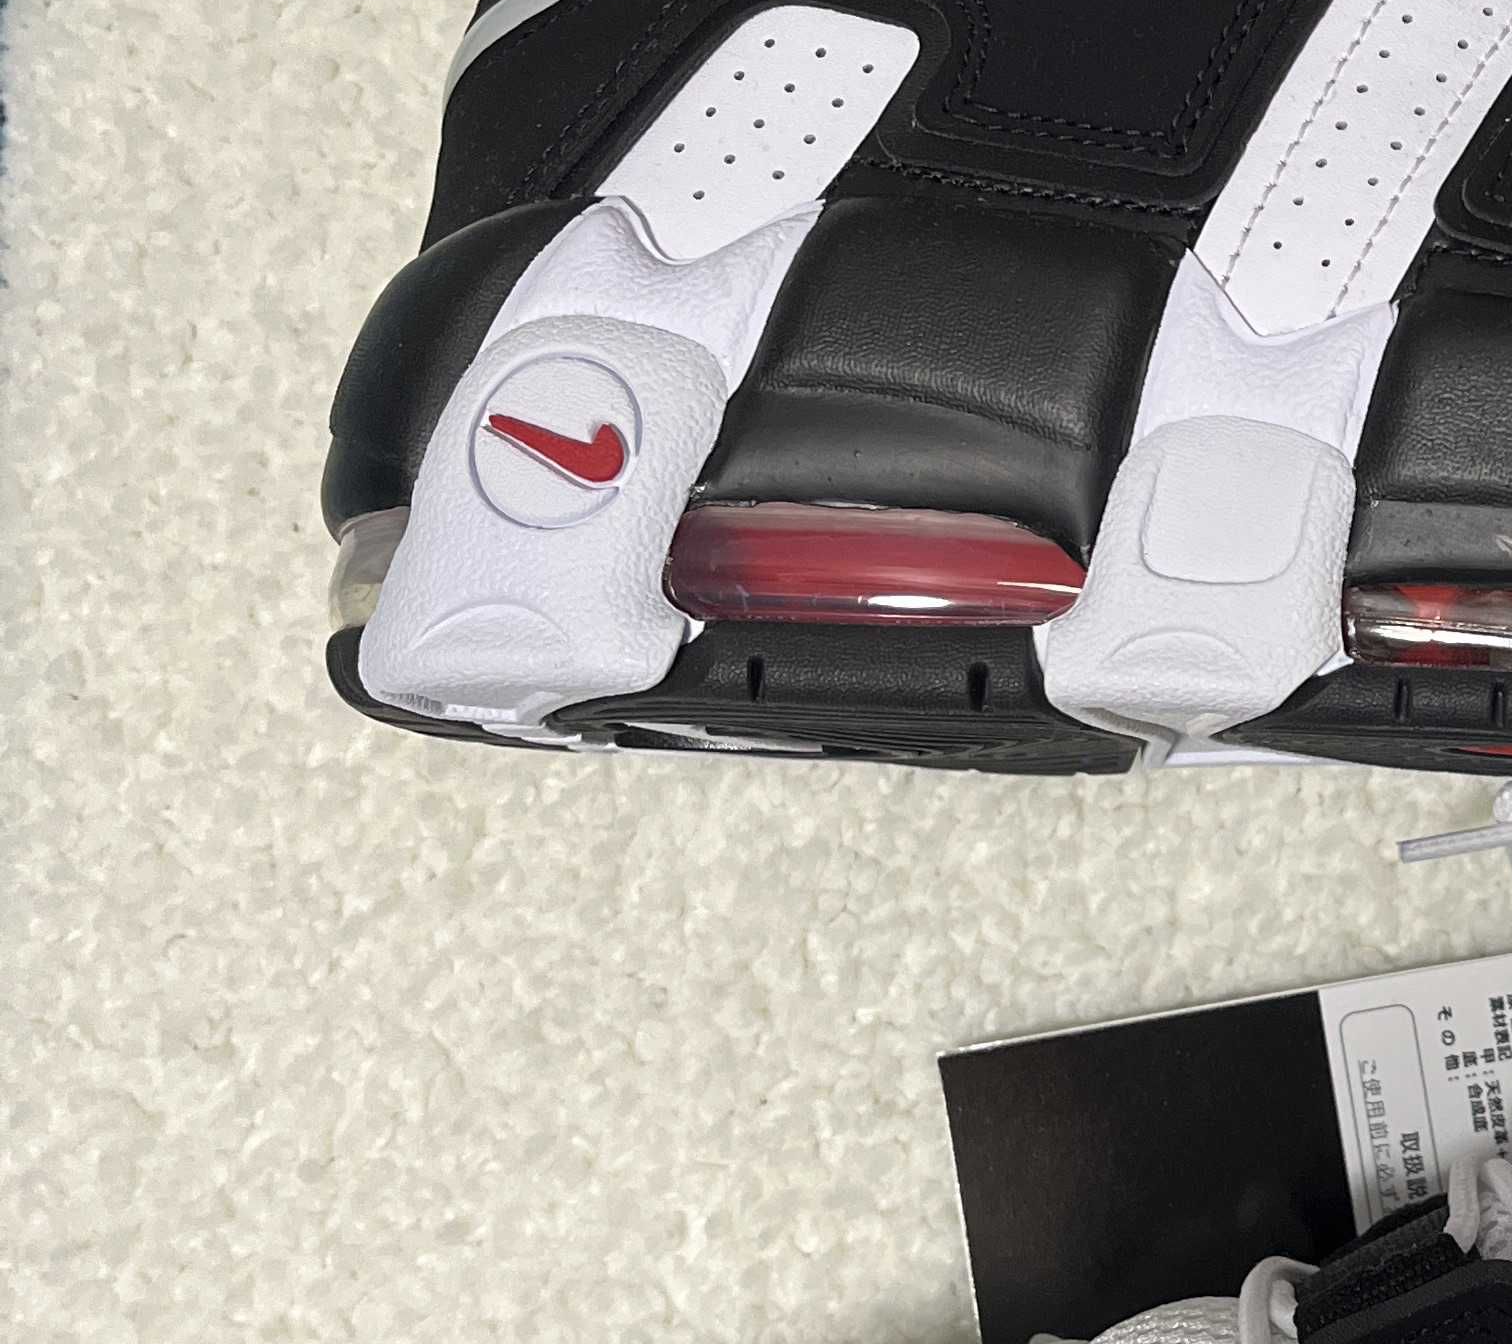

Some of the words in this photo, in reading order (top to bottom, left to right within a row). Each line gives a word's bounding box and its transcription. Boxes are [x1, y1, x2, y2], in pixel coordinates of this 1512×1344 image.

[1489, 996, 1512, 1061] 素材表記
[1359, 1059, 1399, 1212] ご使用前に必ず
[1401, 1131, 1427, 1199] 取扱説
